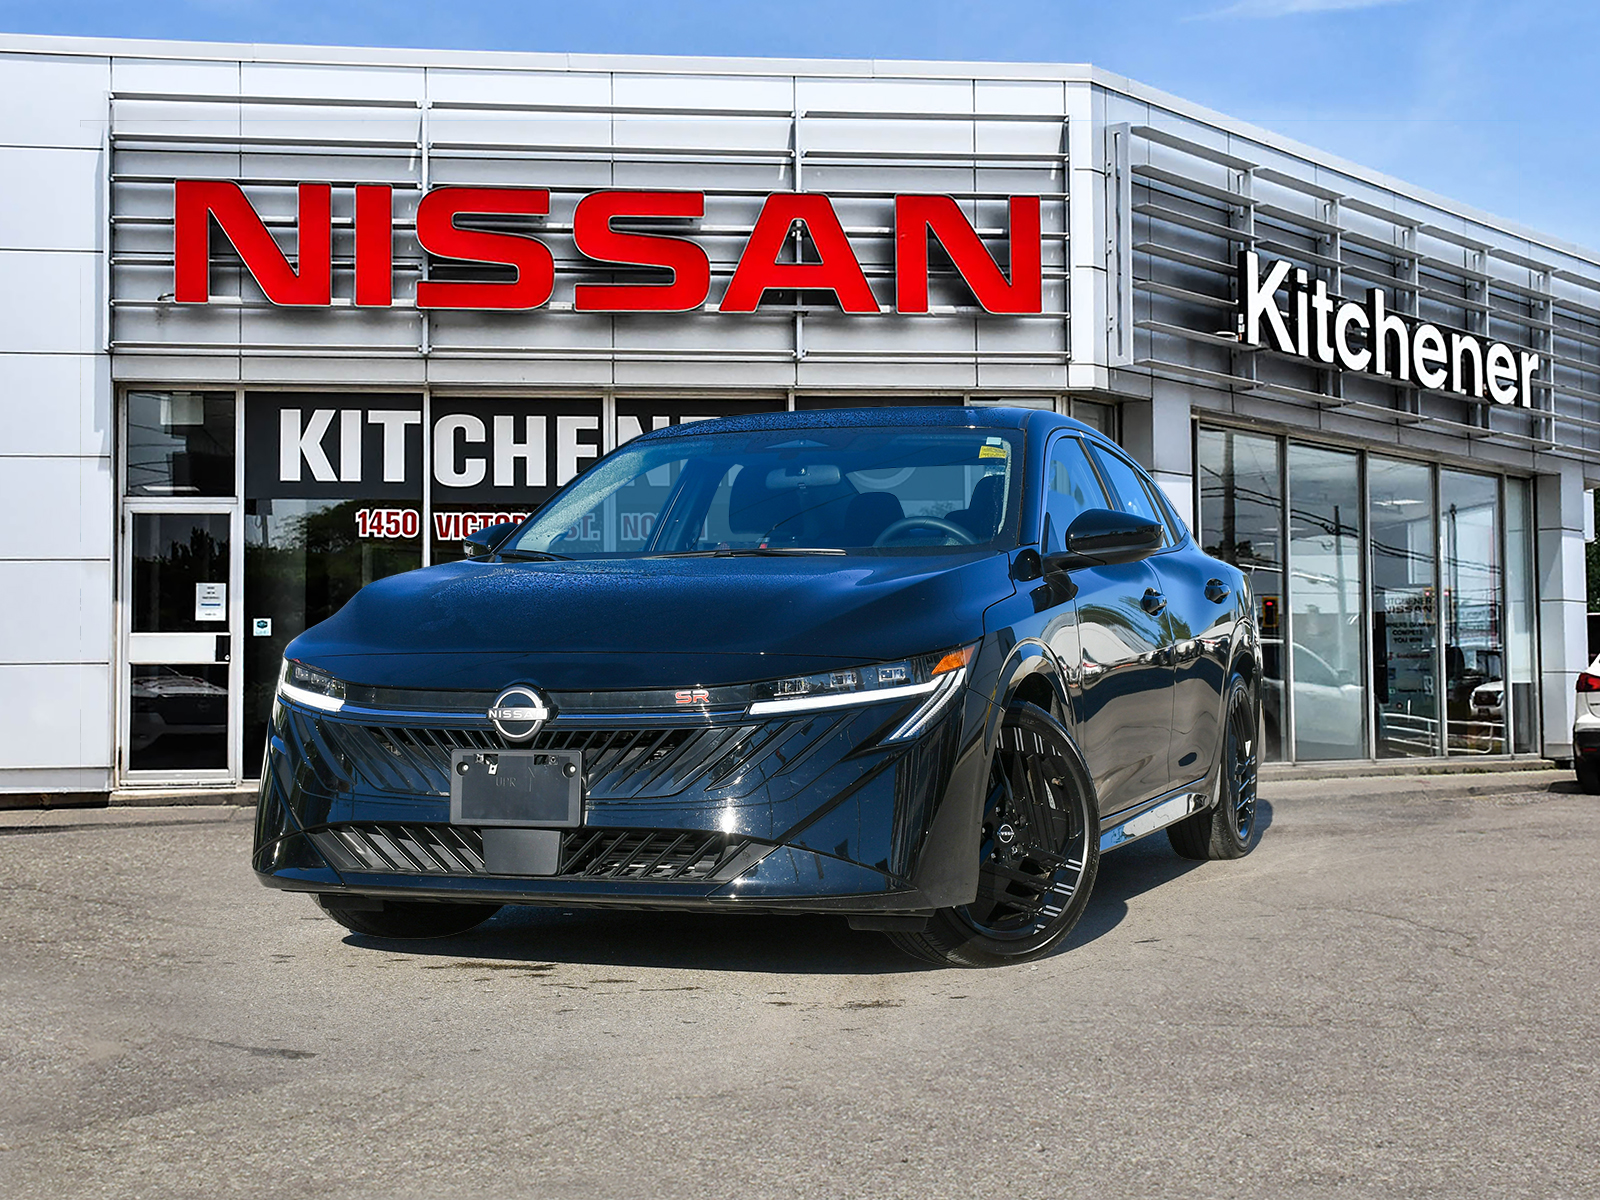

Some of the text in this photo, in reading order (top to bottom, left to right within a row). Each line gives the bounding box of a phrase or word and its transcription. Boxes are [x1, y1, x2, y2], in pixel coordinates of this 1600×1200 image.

[174, 179, 1043, 315] NISSAN
[1243, 250, 1539, 408] Kitchener
[279, 408, 740, 487] KITCHEN
[355, 508, 419, 539] 1450
[488, 709, 547, 719] NISSAN
[674, 689, 711, 705] SR
